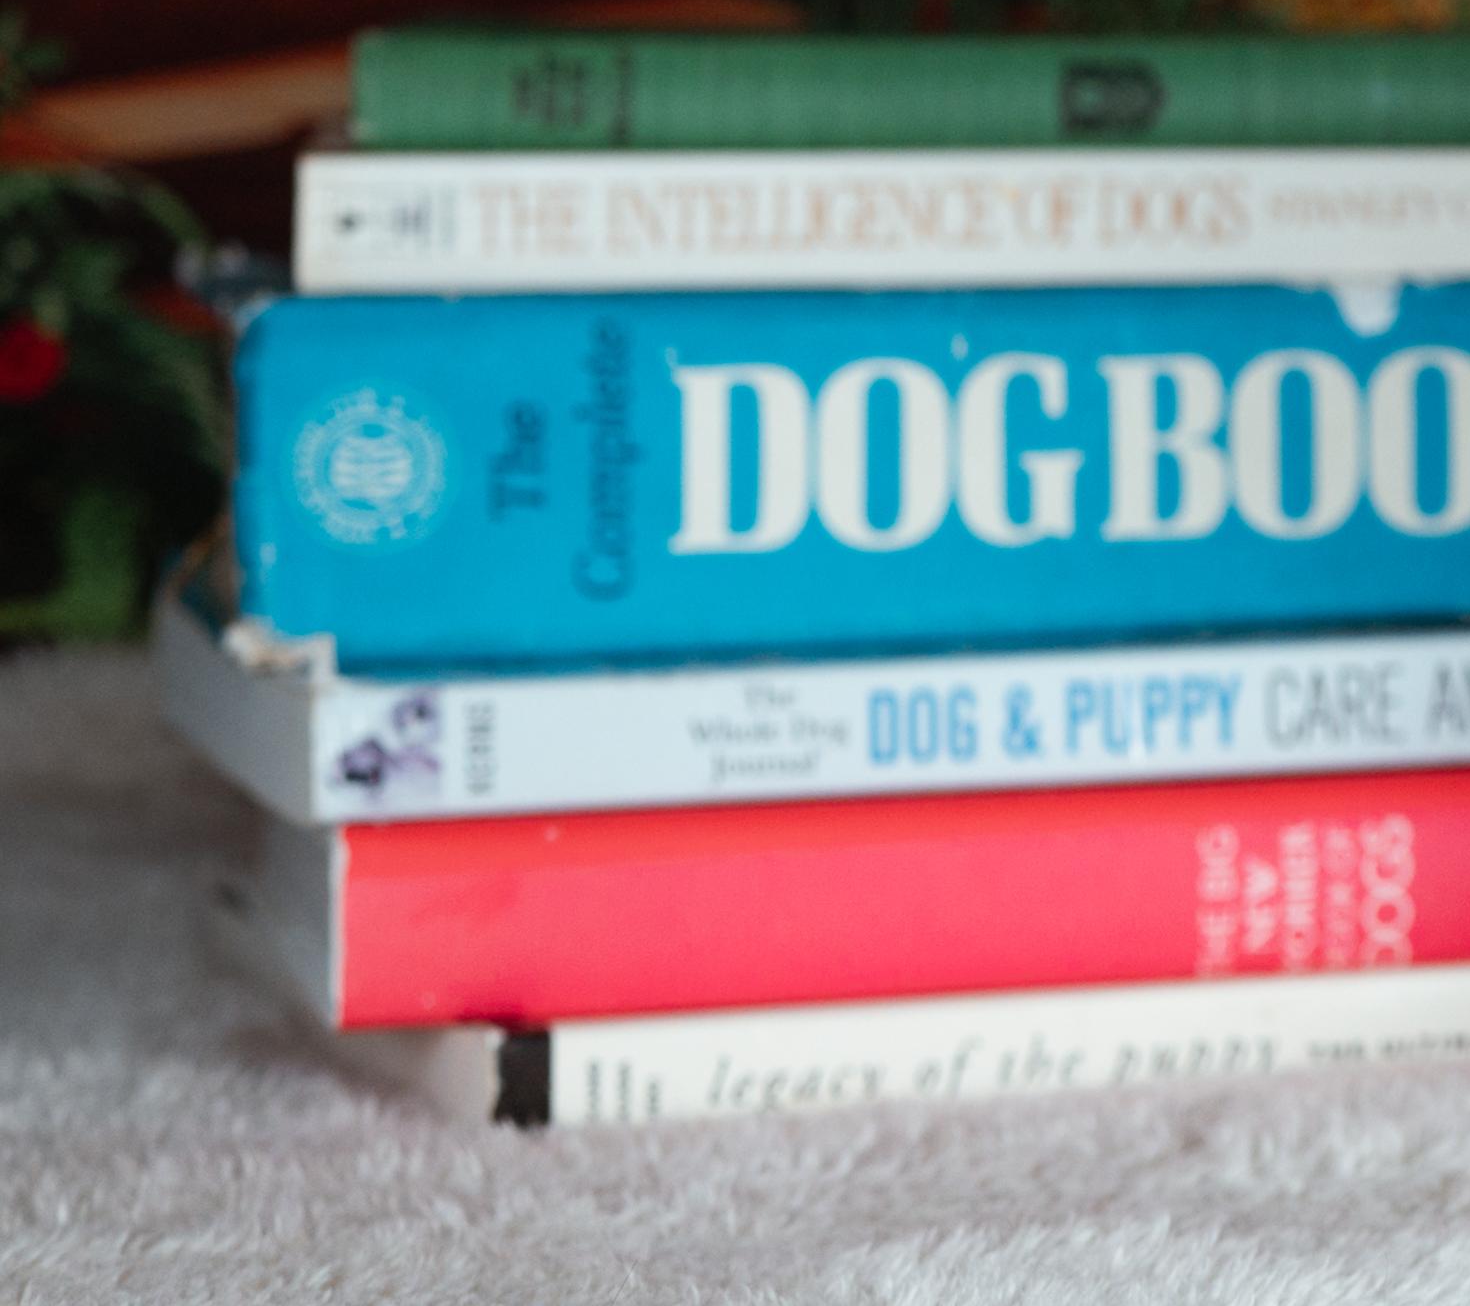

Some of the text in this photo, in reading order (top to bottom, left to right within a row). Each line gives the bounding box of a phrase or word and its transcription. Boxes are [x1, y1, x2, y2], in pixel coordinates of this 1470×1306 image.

[471, 180, 584, 258] THE
[603, 178, 1006, 255] INTELLIGENCE
[1010, 176, 1079, 249] OF
[1094, 172, 1254, 247] DOGS
[488, 399, 547, 521] The
[571, 315, 646, 602] Complete
[668, 349, 1085, 556] DOG
[867, 686, 979, 767] DOG
[1003, 684, 1044, 760] &
[1064, 672, 1243, 755] PUPPY
[1260, 661, 1404, 750] CARE
[706, 1052, 883, 1112] legacy
[912, 1035, 984, 1095] of
[998, 1034, 1084, 1087] the
